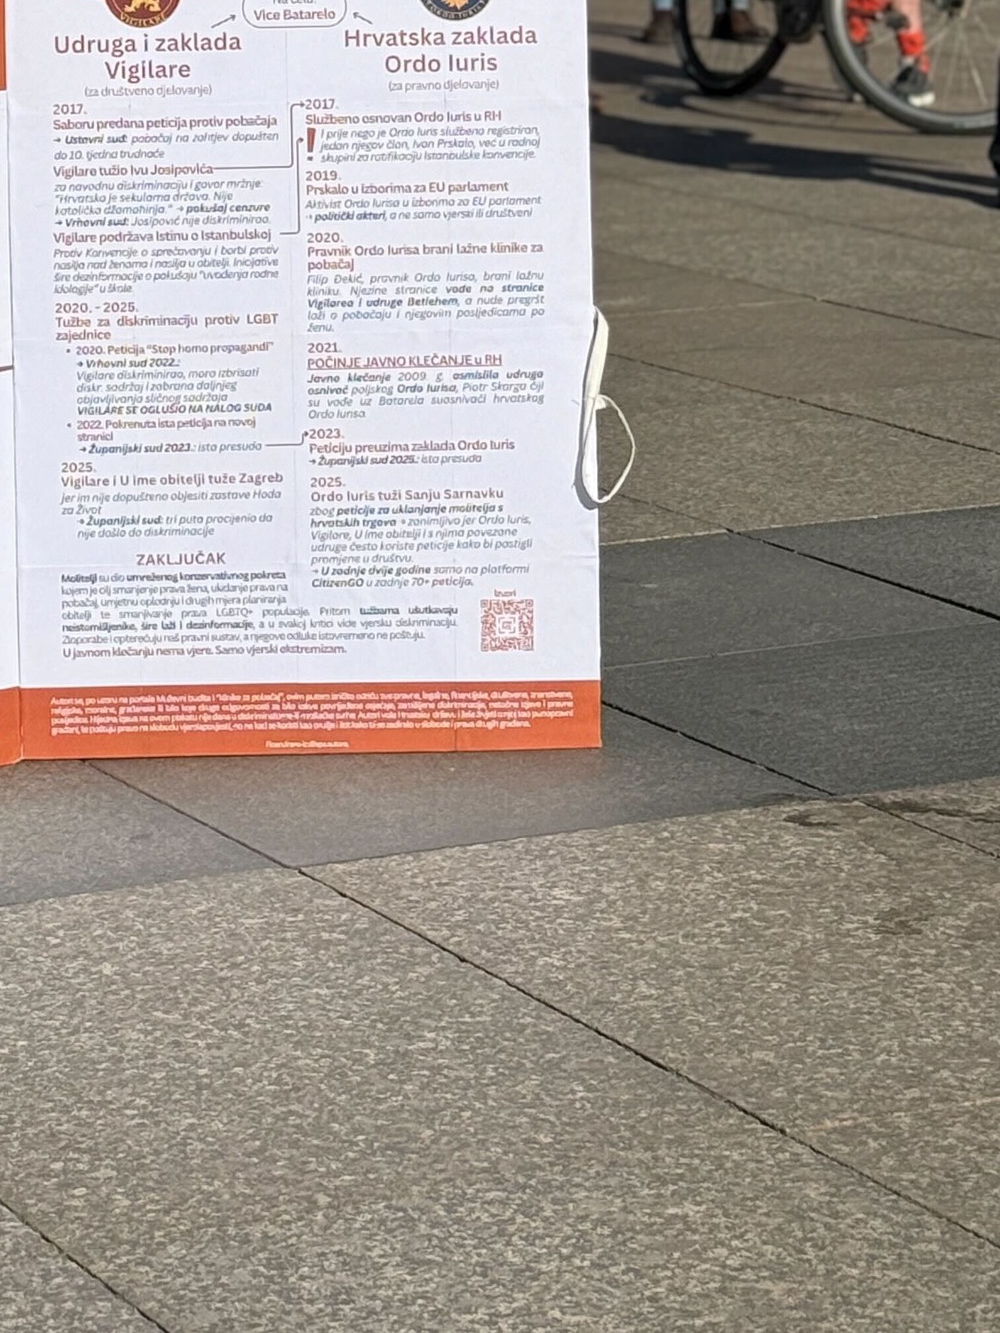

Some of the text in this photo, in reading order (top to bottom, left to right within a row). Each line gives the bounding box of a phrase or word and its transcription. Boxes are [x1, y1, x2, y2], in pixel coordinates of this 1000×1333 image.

[254, 7, 336, 21] Vice Batarelo
[344, 24, 538, 48] Hrvatska zaklada
[54, 31, 242, 58] Udruga i zaklada
[385, 52, 498, 74] Ordo Iuris
[104, 59, 191, 84] Vigilare
[404, 81, 442, 93] pravno
[53, 103, 87, 115] 2017.
[305, 97, 339, 110] 2017.
[53, 114, 278, 132] Saboru predana peticija protiv pobačaja
[305, 112, 360, 125] Službeno
[361, 114, 412, 124] osnovan
[413, 110, 444, 123] Ordo
[446, 110, 472, 123] Iuris
[53, 162, 214, 180] Vigilare tužio Ivu Josipovića
[305, 169, 342, 182] 2019.
[306, 182, 349, 196] Prskalo
[360, 181, 412, 194] izborima
[412, 184, 427, 193] za
[428, 181, 446, 193] EU
[447, 180, 509, 195] parlament
[53, 227, 272, 246] Vigilare podržava Istinu o Istanbulskoj
[307, 231, 344, 244] 2020.
[307, 244, 352, 258] Pravnik
[354, 244, 385, 256] Ordo
[387, 243, 420, 256] Iurisa
[456, 242, 488, 254] lažne
[490, 241, 528, 254] klinike
[530, 243, 544, 253] za
[307, 257, 354, 273] pobačaj
[55, 302, 93, 314] 2020.
[102, 301, 139, 313] 2025.
[55, 312, 279, 329] Tužbe za diskriminaciju protiv LGBT
[55, 330, 111, 343] zajednice
[75, 345, 106, 356] 2020.
[107, 343, 146, 357] Peticija
[177, 343, 209, 354] homo
[307, 341, 342, 354] 2021.
[86, 357, 127, 369] Vrhovni
[128, 357, 148, 368] sud
[307, 355, 362, 369] POČINJE
[363, 355, 408, 368] JAVNO
[408, 352, 474, 367] KLEČANJE
[77, 403, 125, 415] VIGILARE
[139, 402, 187, 414] OGLUŠIO
[187, 403, 204, 414] NA
[204, 401, 242, 413] NALOG
[242, 402, 272, 413] SUDA
[103, 418, 157, 432] Pokrenuta
[157, 417, 176, 429] ista
[176, 417, 213, 431] peticija
[213, 419, 227, 427] na
[227, 415, 256, 429] novoj
[308, 427, 345, 440] 2023.
[87, 442, 143, 456] Županijski
[143, 442, 164, 453] sud
[197, 443, 218, 452] ista
[218, 440, 262, 454] presuda
[309, 437, 515, 457] Peticiju preuzima zaklada Ordo Iuris
[61, 461, 97, 473] 2025.
[61, 475, 110, 490] Vigilare
[119, 474, 129, 486] U
[132, 473, 157, 486] ime
[159, 472, 205, 488] obitelji
[207, 472, 236, 485] tuže
[238, 471, 284, 487] Zagreb
[310, 476, 346, 488] 2025.
[311, 486, 504, 503] Ordo Iuris tuži Sanju Sarnavku
[135, 550, 226, 566] ZAKLJUČAK
